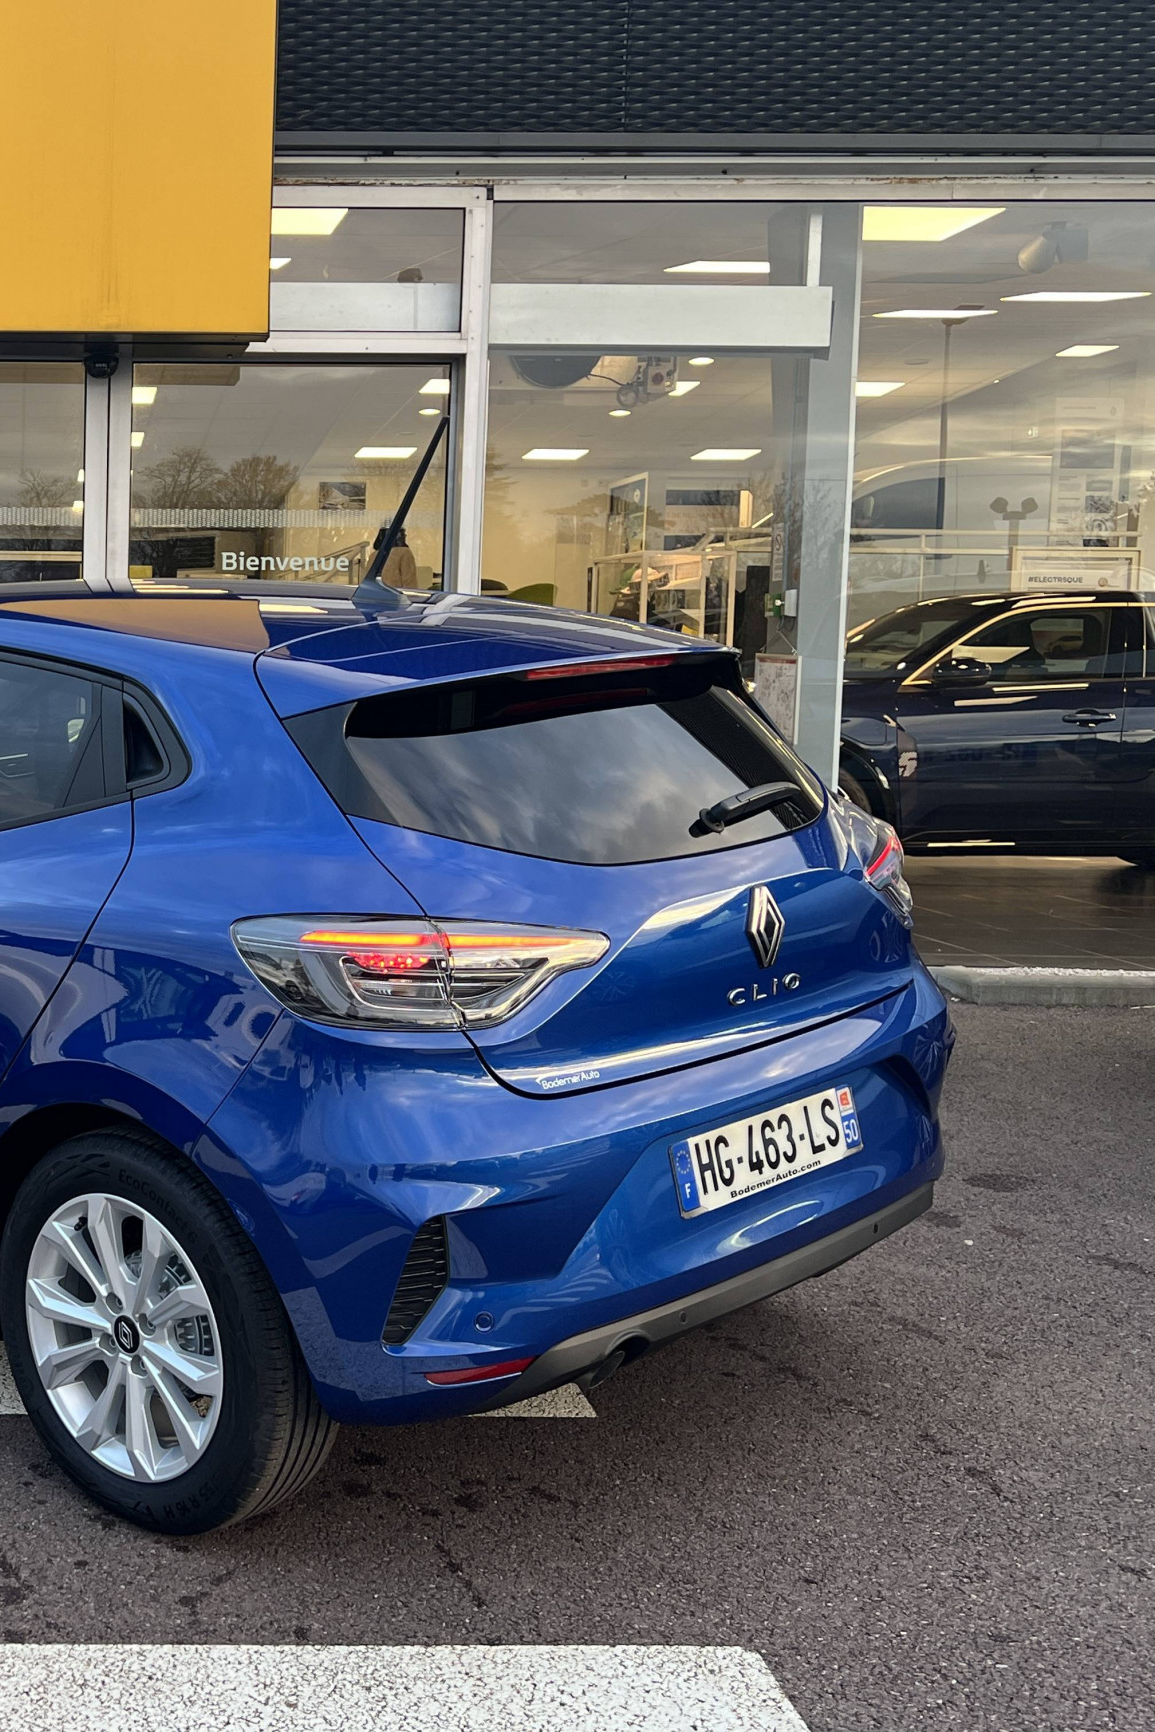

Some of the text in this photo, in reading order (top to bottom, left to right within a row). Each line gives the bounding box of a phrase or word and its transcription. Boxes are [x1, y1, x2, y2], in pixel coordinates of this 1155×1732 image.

[221, 551, 350, 572] Bienvenue
[727, 972, 801, 1007] CLIO
[541, 1070, 600, 1090] BodemerAuto
[844, 1118, 859, 1143] 50
[694, 1098, 840, 1195] HG-463-LS
[684, 1183, 692, 1198] F
[730, 1159, 822, 1199] BodemerAuto.com
[118, 1168, 188, 1231] EcoContact
